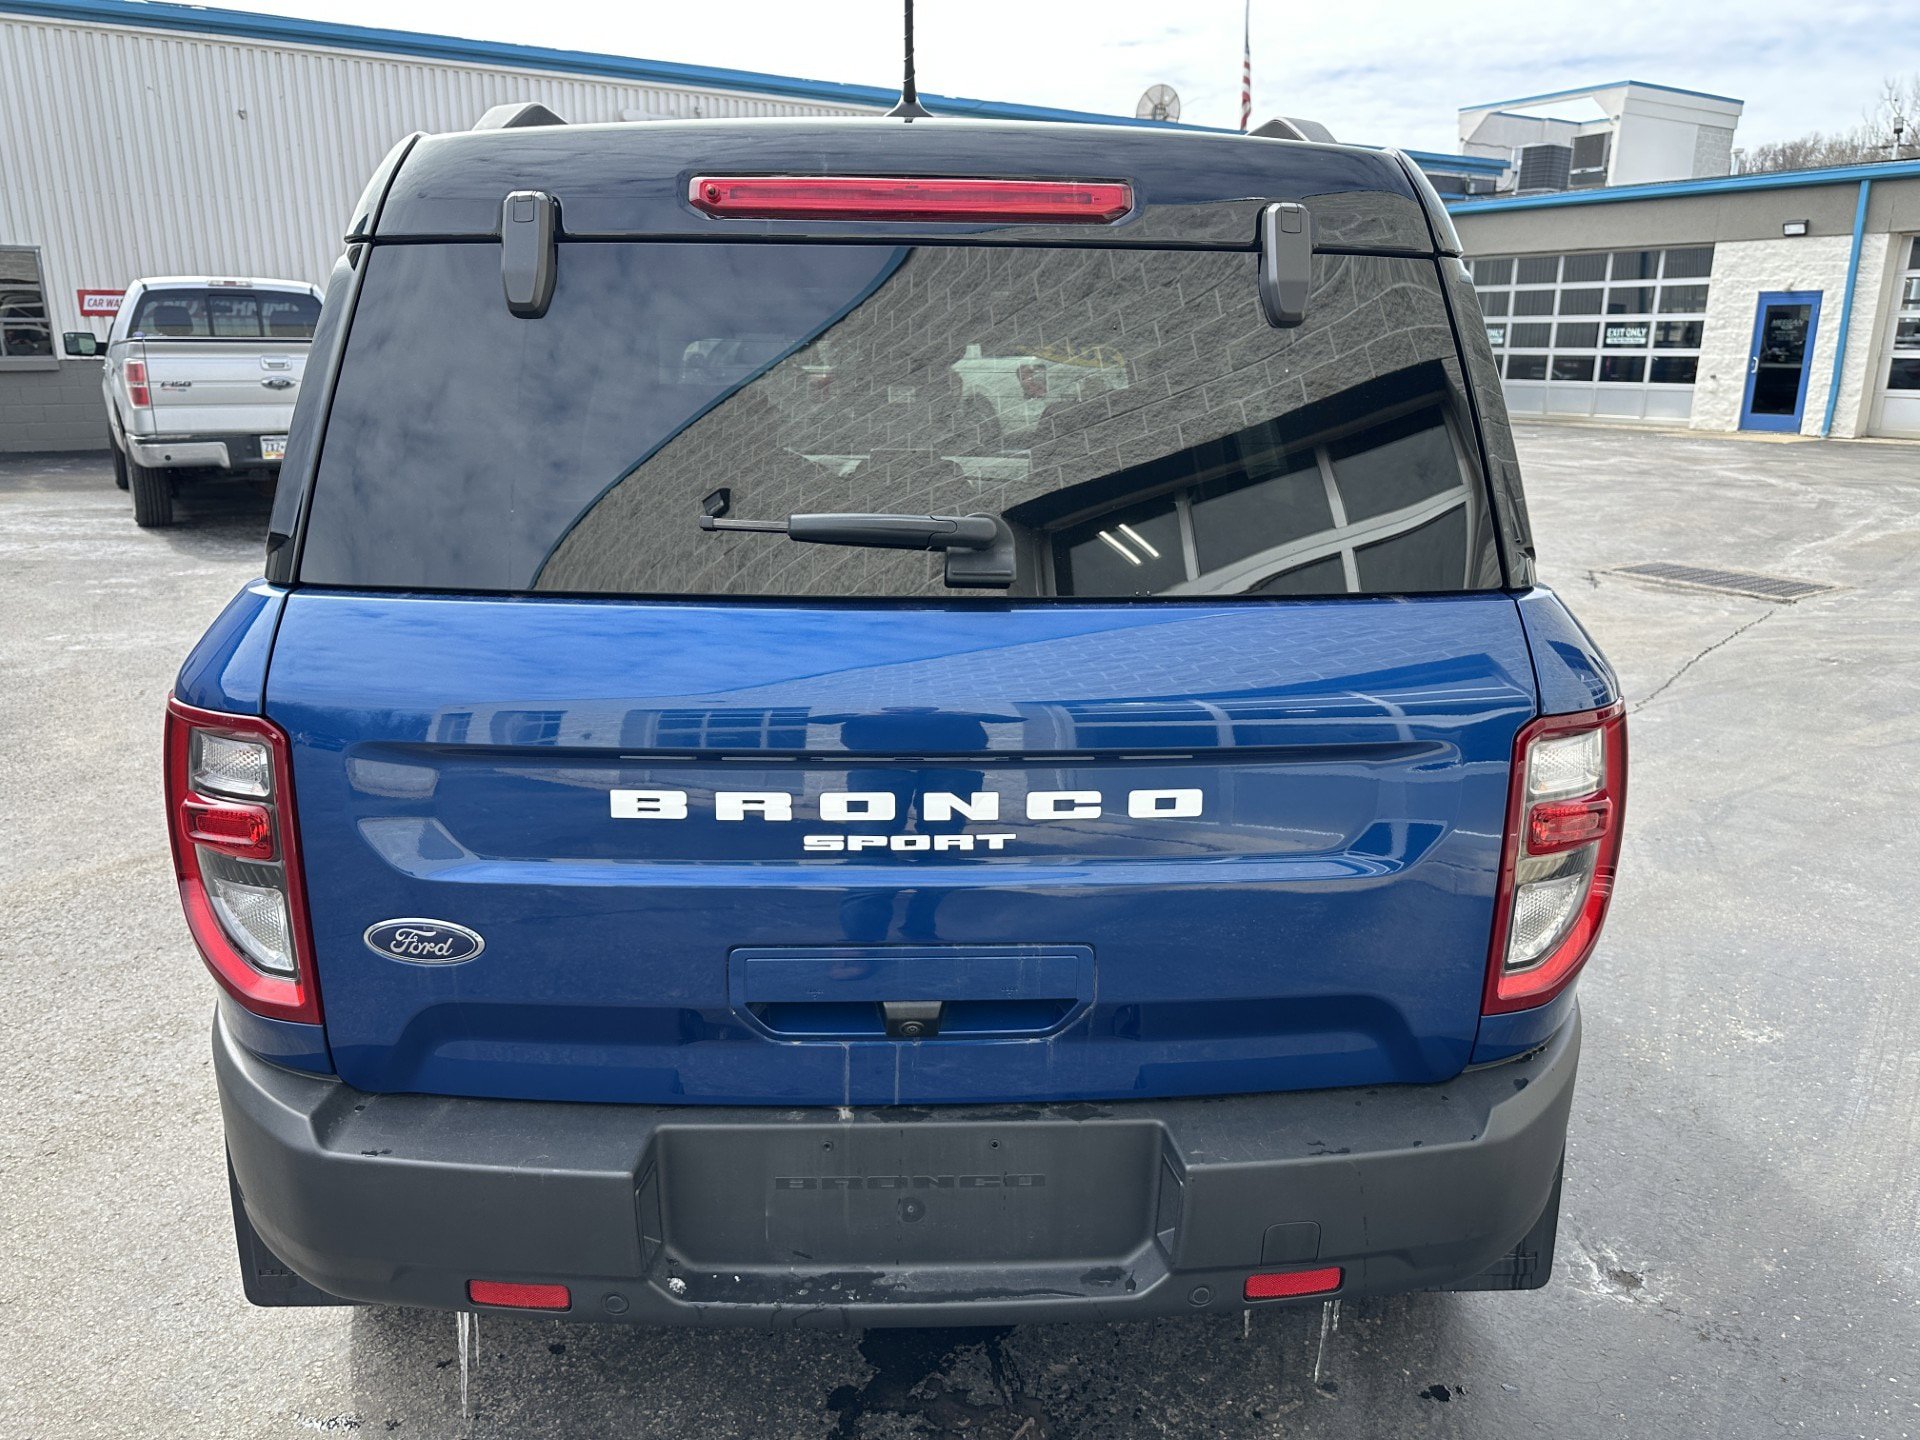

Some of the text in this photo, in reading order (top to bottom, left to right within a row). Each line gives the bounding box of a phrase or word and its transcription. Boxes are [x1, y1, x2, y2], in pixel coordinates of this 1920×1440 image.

[87, 298, 104, 308] CAR
[1606, 327, 1648, 337] EXIT ONLY
[609, 788, 1203, 822] BRONCO
[802, 833, 1017, 851] SPORT
[390, 927, 453, 956] Ford
[775, 1173, 1046, 1190] BRONCO
